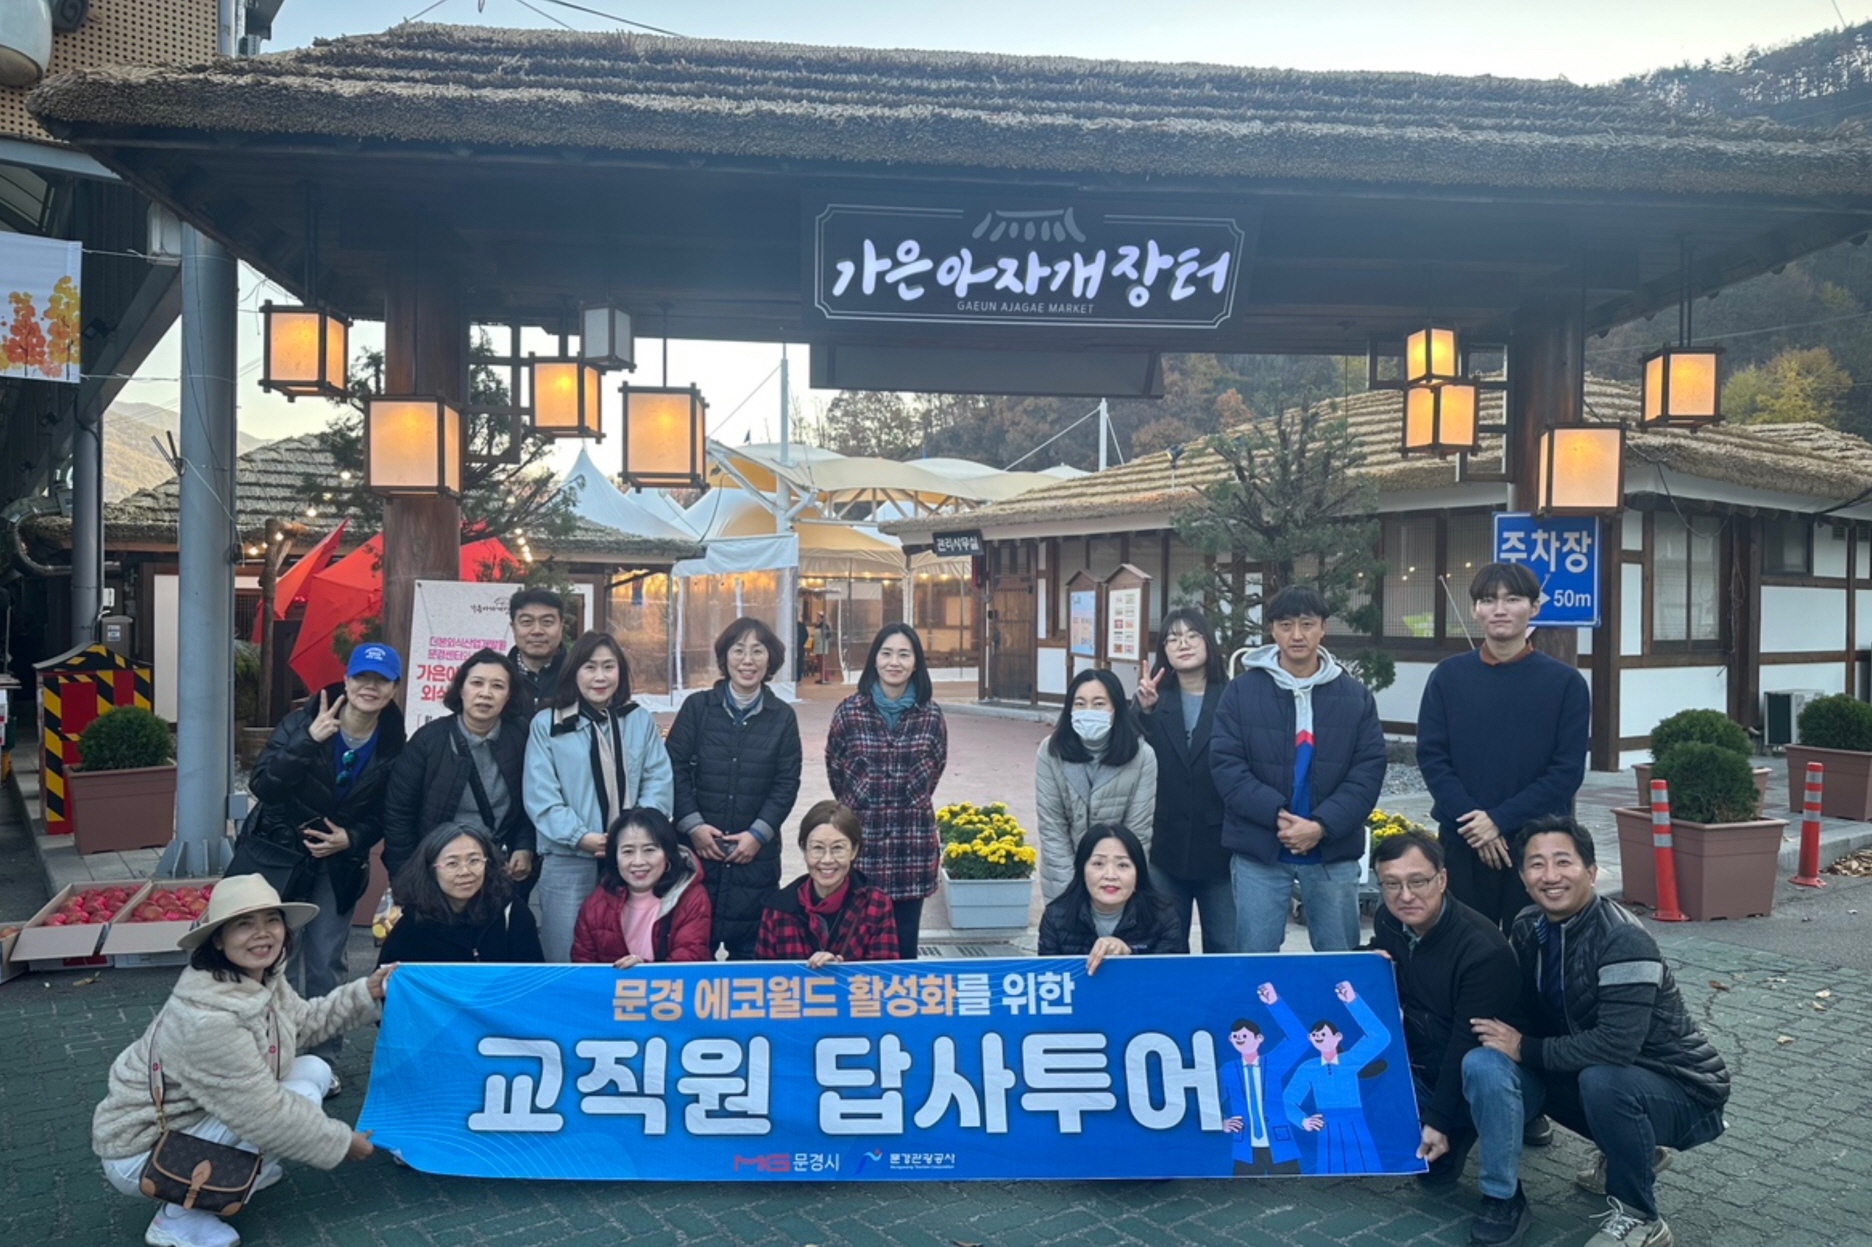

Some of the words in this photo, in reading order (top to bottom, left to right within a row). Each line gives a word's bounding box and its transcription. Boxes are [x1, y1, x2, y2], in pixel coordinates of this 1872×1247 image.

[957, 301, 997, 311] GAEUN
[1001, 302, 1044, 312] AJAGAE
[1048, 303, 1094, 313] MARKET
[1500, 529, 1592, 573] 주차장
[1553, 589, 1592, 607] 50m
[613, 978, 684, 1021] 문경
[694, 976, 838, 1020] 에코월드
[847, 973, 991, 1018] 활성화를
[1002, 972, 1075, 1015] 위한
[466, 1033, 772, 1136] 교직원
[815, 1029, 1224, 1136] 답사투어
[793, 1153, 840, 1172] 문경시
